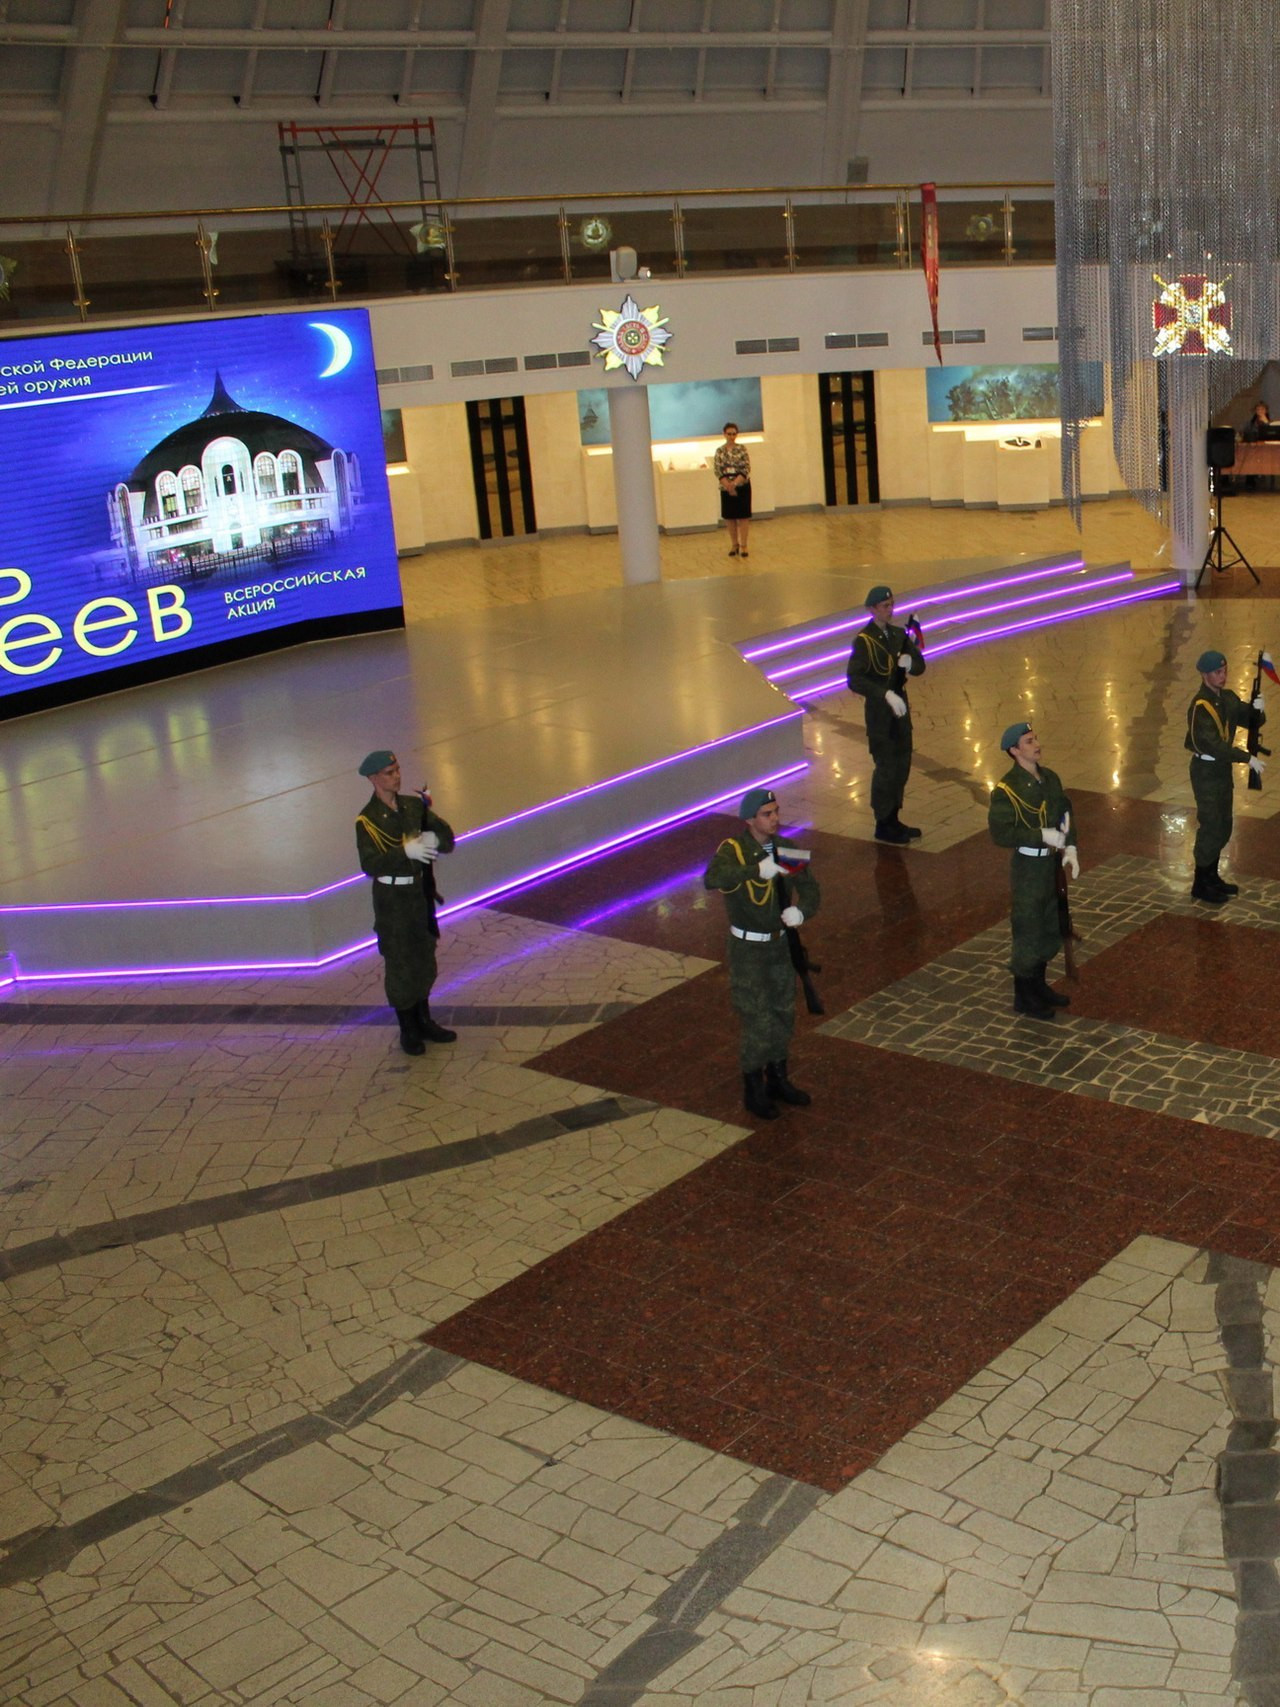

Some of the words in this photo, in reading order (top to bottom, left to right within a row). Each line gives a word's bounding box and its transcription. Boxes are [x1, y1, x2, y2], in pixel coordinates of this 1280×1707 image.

[0, 360, 45, 377] ской
[50, 351, 153, 371] Федерации
[24, 375, 91, 394] оружия
[224, 566, 366, 604] ВСЕРОССИЙСКАЯ
[227, 597, 276, 620] АКЦИЯ
